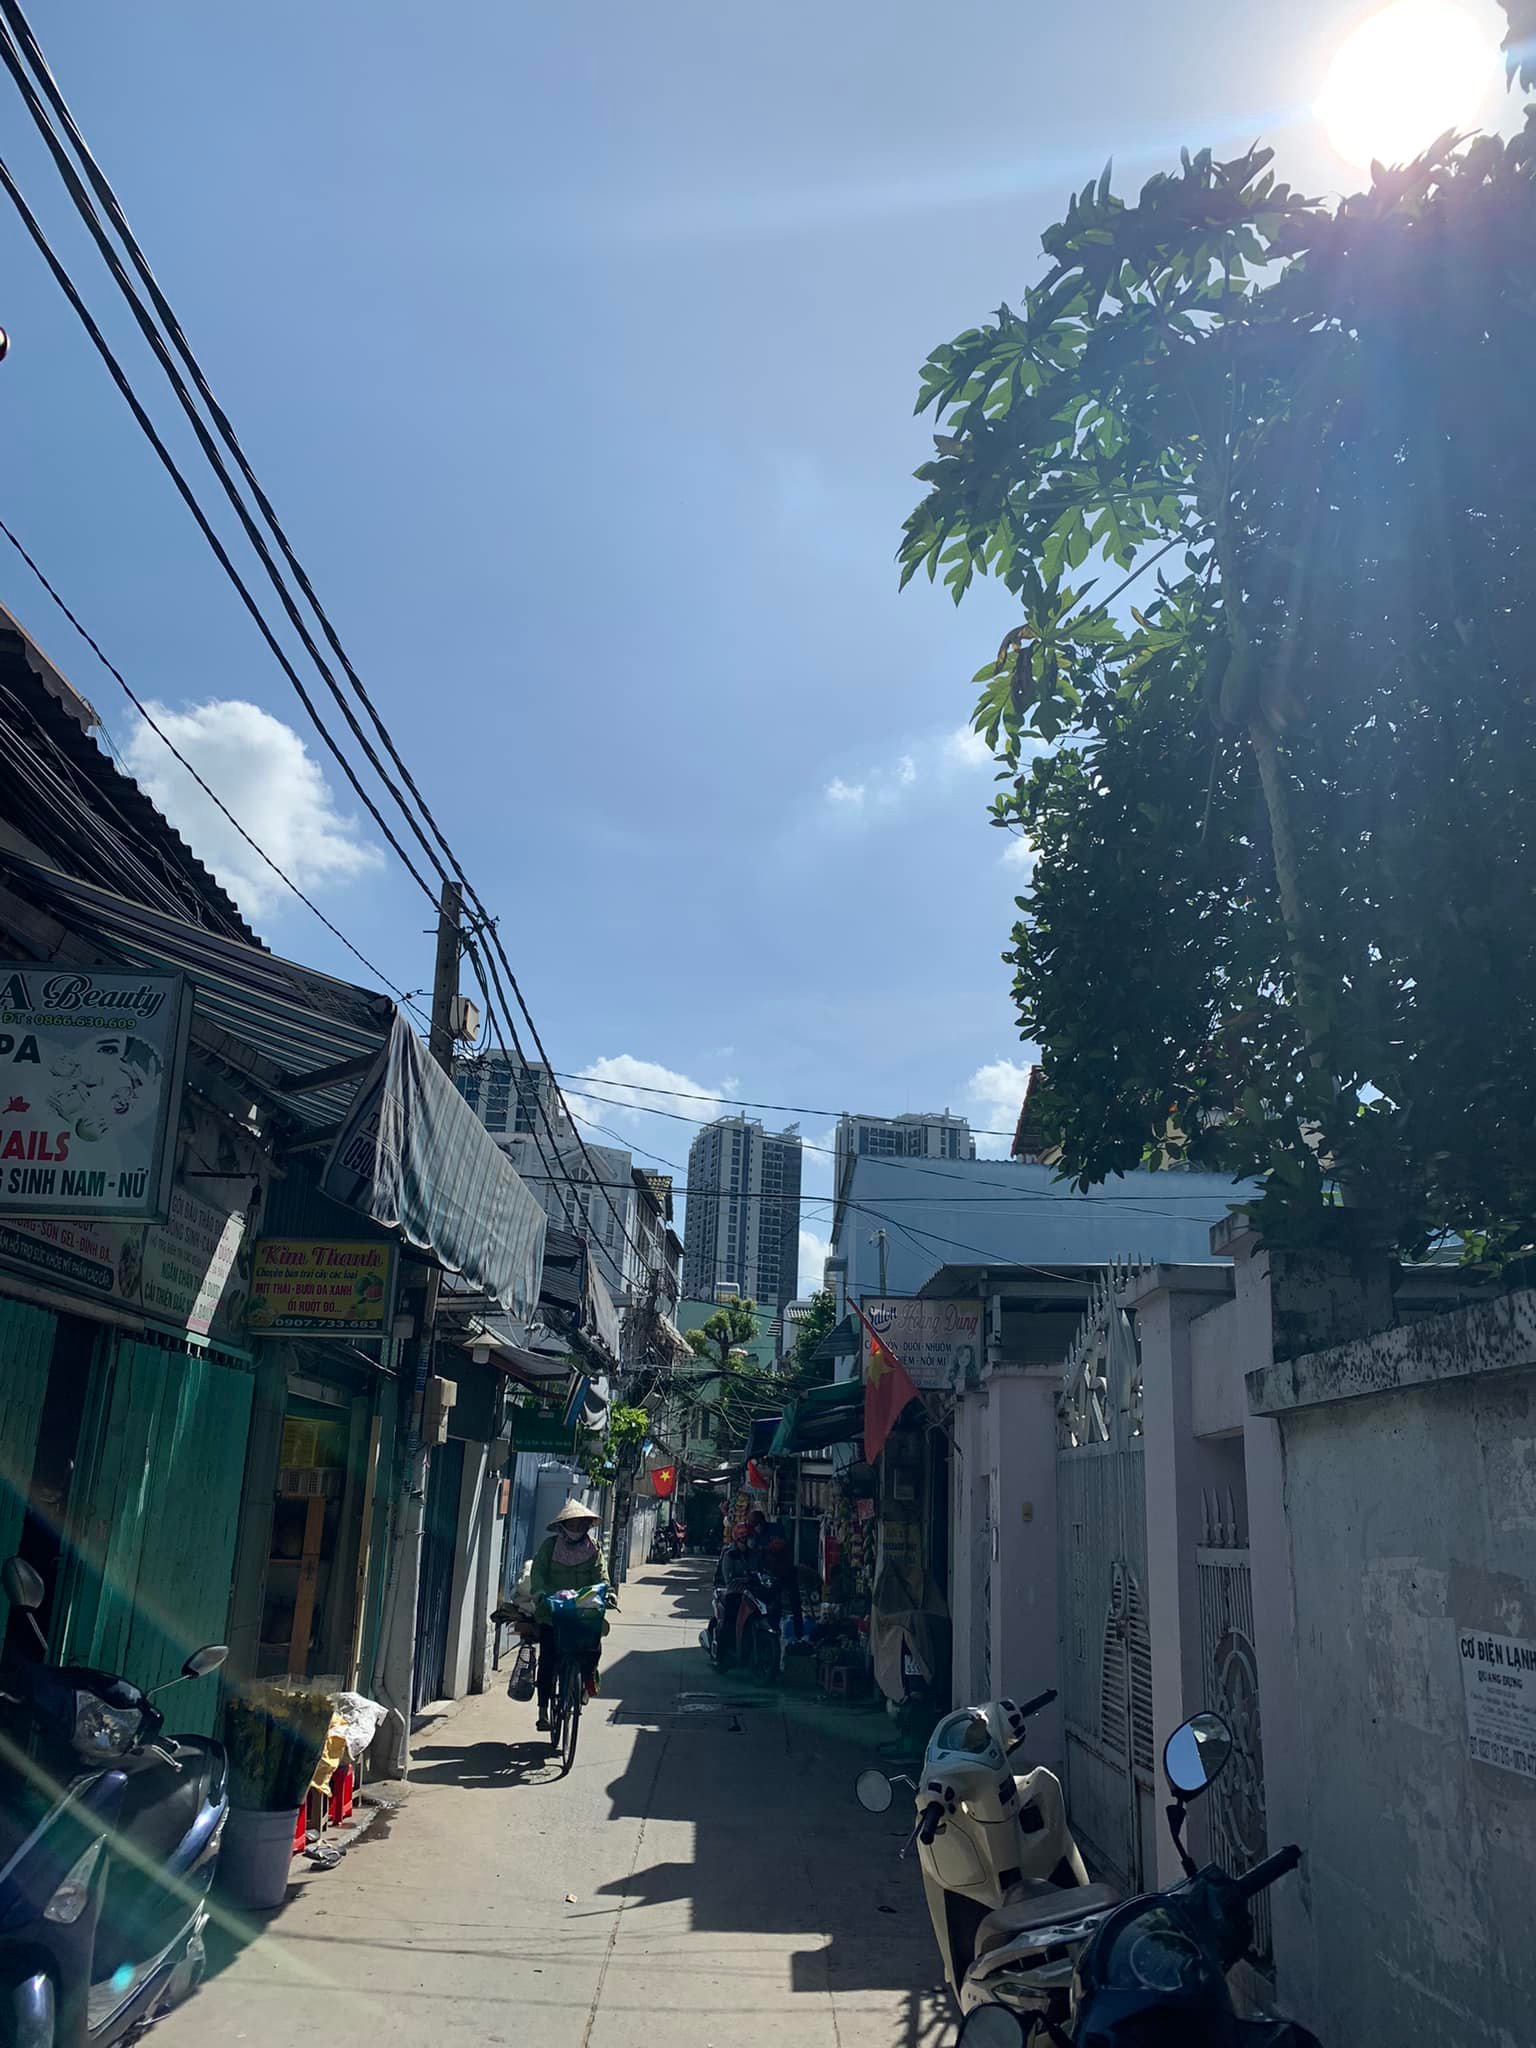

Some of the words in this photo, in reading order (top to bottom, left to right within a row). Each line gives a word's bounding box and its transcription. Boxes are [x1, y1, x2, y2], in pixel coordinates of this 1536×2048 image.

[43, 974, 166, 1019] Beauty
[34, 1013, 137, 1030] 0866.630.609
[8, 1168, 56, 1195] SINH
[61, 1169, 106, 1197] NAM
[119, 1168, 149, 1198] NỮ
[262, 1246, 308, 1265] Kim
[312, 1247, 383, 1267] Thanh
[869, 1303, 897, 1326] Salon
[1478, 1637, 1503, 1667] ĐIỆN
